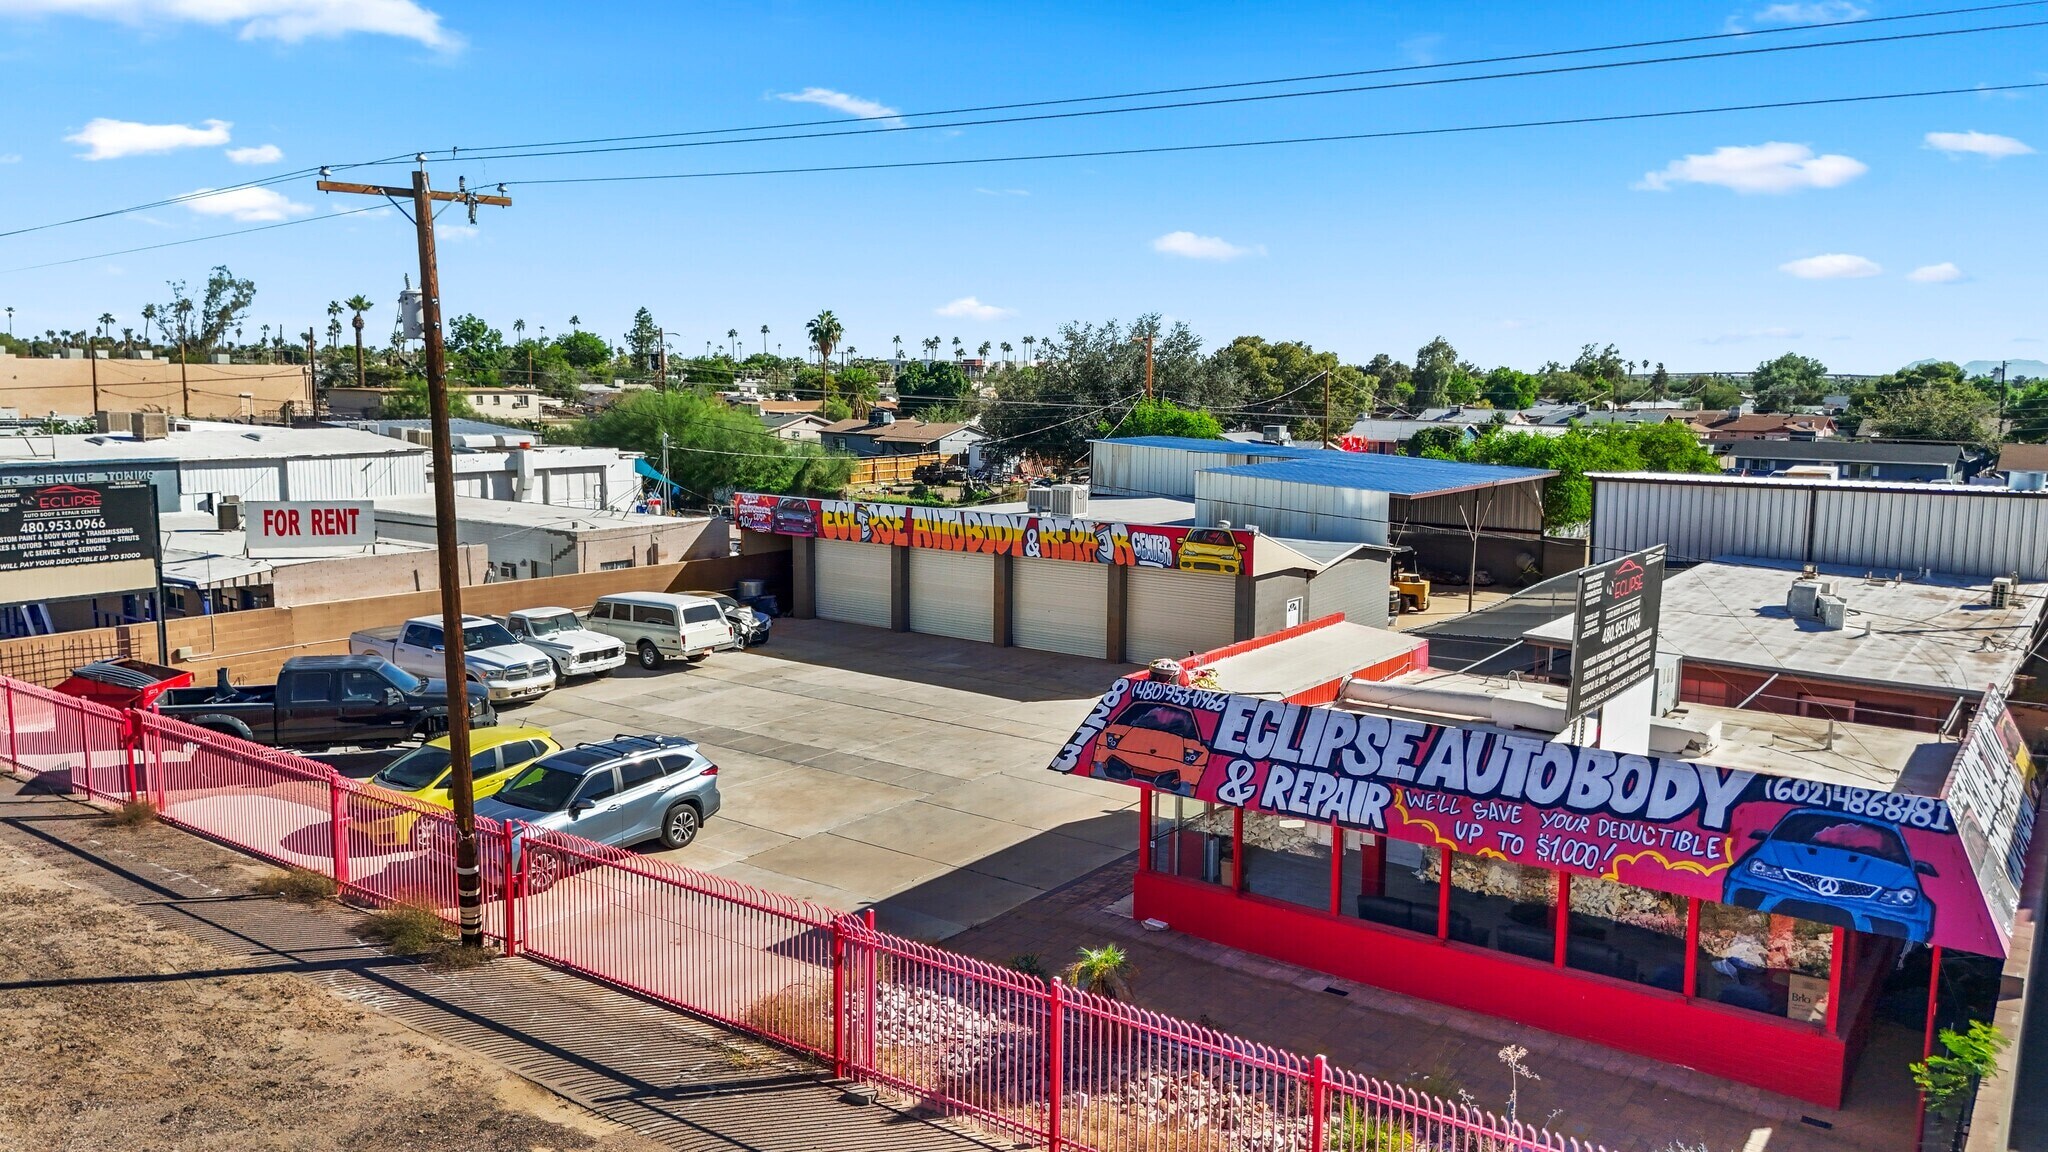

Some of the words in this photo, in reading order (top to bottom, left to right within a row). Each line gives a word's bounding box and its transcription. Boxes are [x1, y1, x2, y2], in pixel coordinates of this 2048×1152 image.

[39, 495, 102, 509] ECLIPSE
[19, 534, 37, 542] PAINT
[38, 533, 43, 541] &
[44, 532, 60, 540] BODY
[86, 527, 134, 537] TRANSMISSIONS
[20, 518, 106, 534] 480.953.0966
[263, 508, 301, 537] FOR
[310, 507, 360, 536] RENT
[911, 507, 1029, 558] AUTOBODY
[1026, 528, 1041, 558] &
[1131, 531, 1173, 567] CENTER
[18, 541, 42, 550] ROTORS
[49, 539, 80, 548] TUNE-UPS
[86, 536, 111, 545] ENGINES
[117, 534, 140, 543] STRUTS
[35, 548, 61, 557] SERVICE
[67, 546, 77, 554] OIL
[78, 544, 107, 553] SERVICES
[20, 560, 34, 568] PAY
[35, 558, 55, 566] YOUR
[56, 555, 98, 565] DEDUCTIBLE
[120, 552, 141, 560] $1000
[1614, 573, 1644, 599] ECLIPSE
[1601, 611, 1641, 644] 480.953.0966
[1131, 680, 1229, 712] (480)953-0966
[1050, 678, 1130, 771] 8273
[1213, 693, 1427, 783] ECLIPSE
[1418, 728, 1759, 829] AUTOBODY
[1218, 759, 1257, 806] &
[1261, 764, 1391, 830] REPAIR
[1405, 790, 1461, 815] WE'LL
[1474, 801, 1523, 825] SAVE
[1540, 812, 1589, 834] YOUR
[1597, 819, 1721, 860] DEDUCTIBLE
[1454, 820, 1484, 845] UP
[1498, 831, 1525, 856] TO
[1536, 833, 1617, 874] $1,000!
